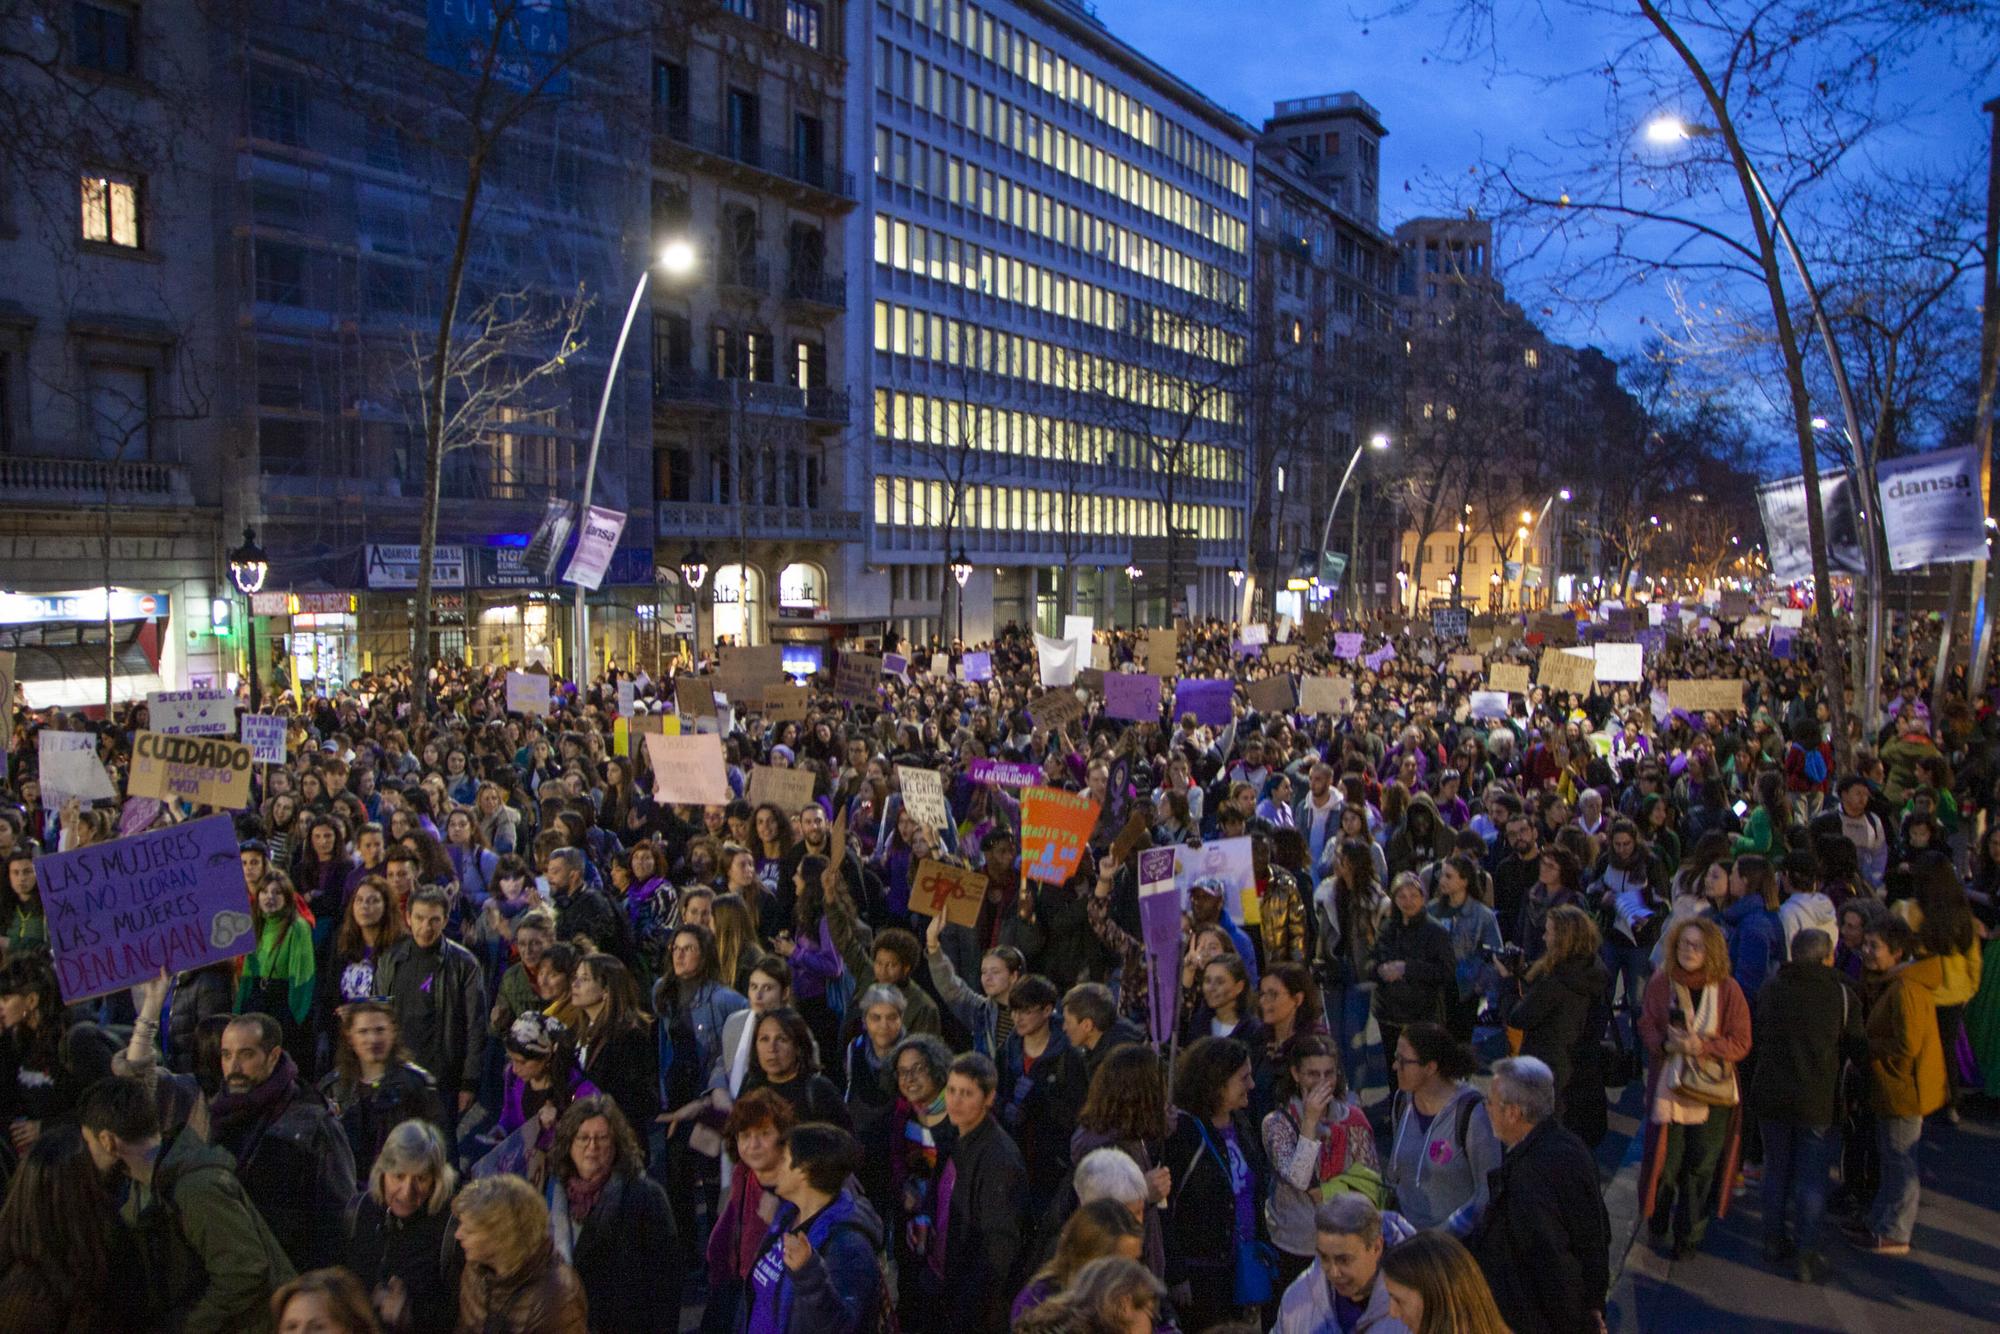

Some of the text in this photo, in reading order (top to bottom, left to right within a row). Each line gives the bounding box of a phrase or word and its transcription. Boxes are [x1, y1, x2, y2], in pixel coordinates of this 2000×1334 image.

[1888, 474, 1970, 499] dansa
[138, 735, 250, 771] CUIDADO
[43, 829, 201, 893] LAS MUJERES
[52, 865, 198, 921] YA NO LLORAN
[57, 892, 199, 954] LAS MUJERES
[58, 919, 208, 997] DENUNCIAN
